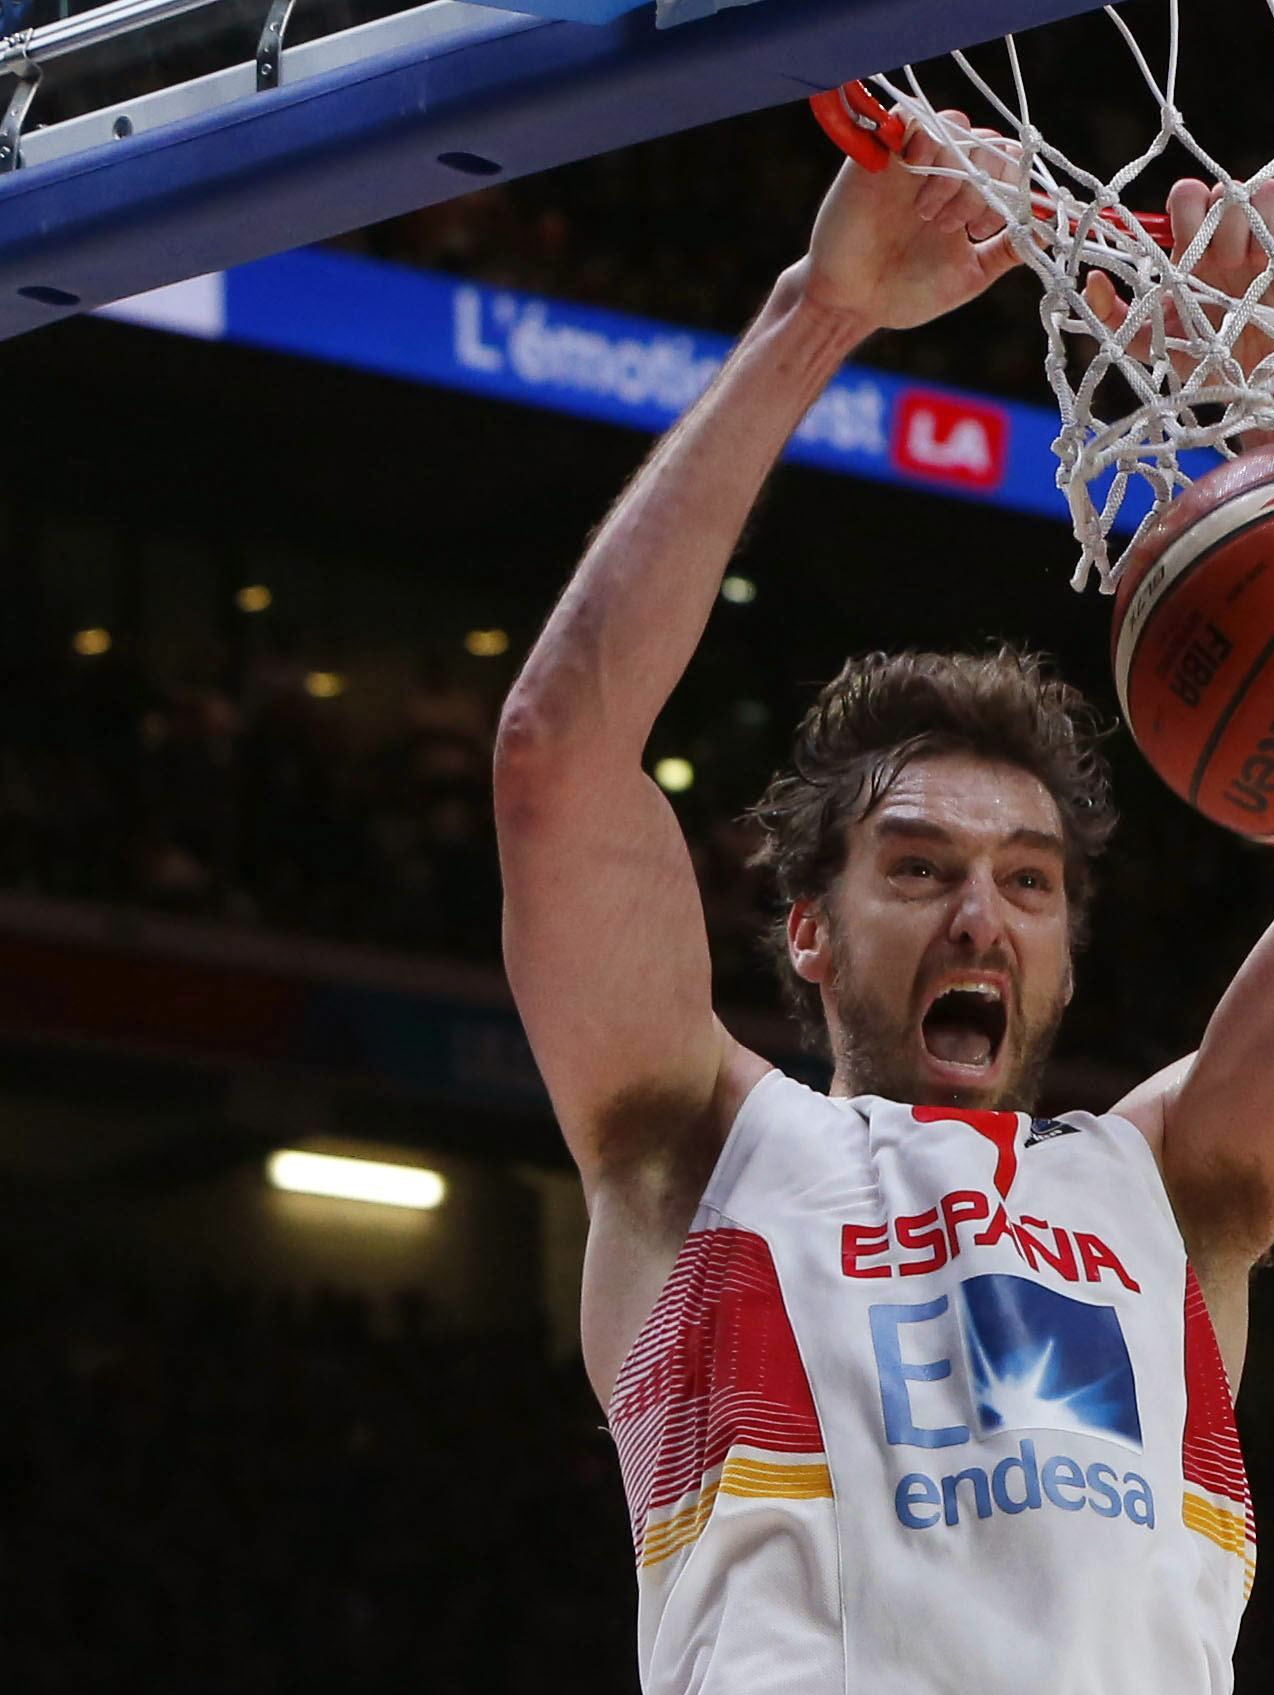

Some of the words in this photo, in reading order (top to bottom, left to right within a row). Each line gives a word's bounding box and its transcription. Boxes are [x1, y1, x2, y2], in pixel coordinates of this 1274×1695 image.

[907, 409, 991, 475] LA
[1168, 621, 1233, 708] FIBA
[840, 1190, 1142, 1294] ESPAÑA
[894, 1438, 1155, 1530] endesa
